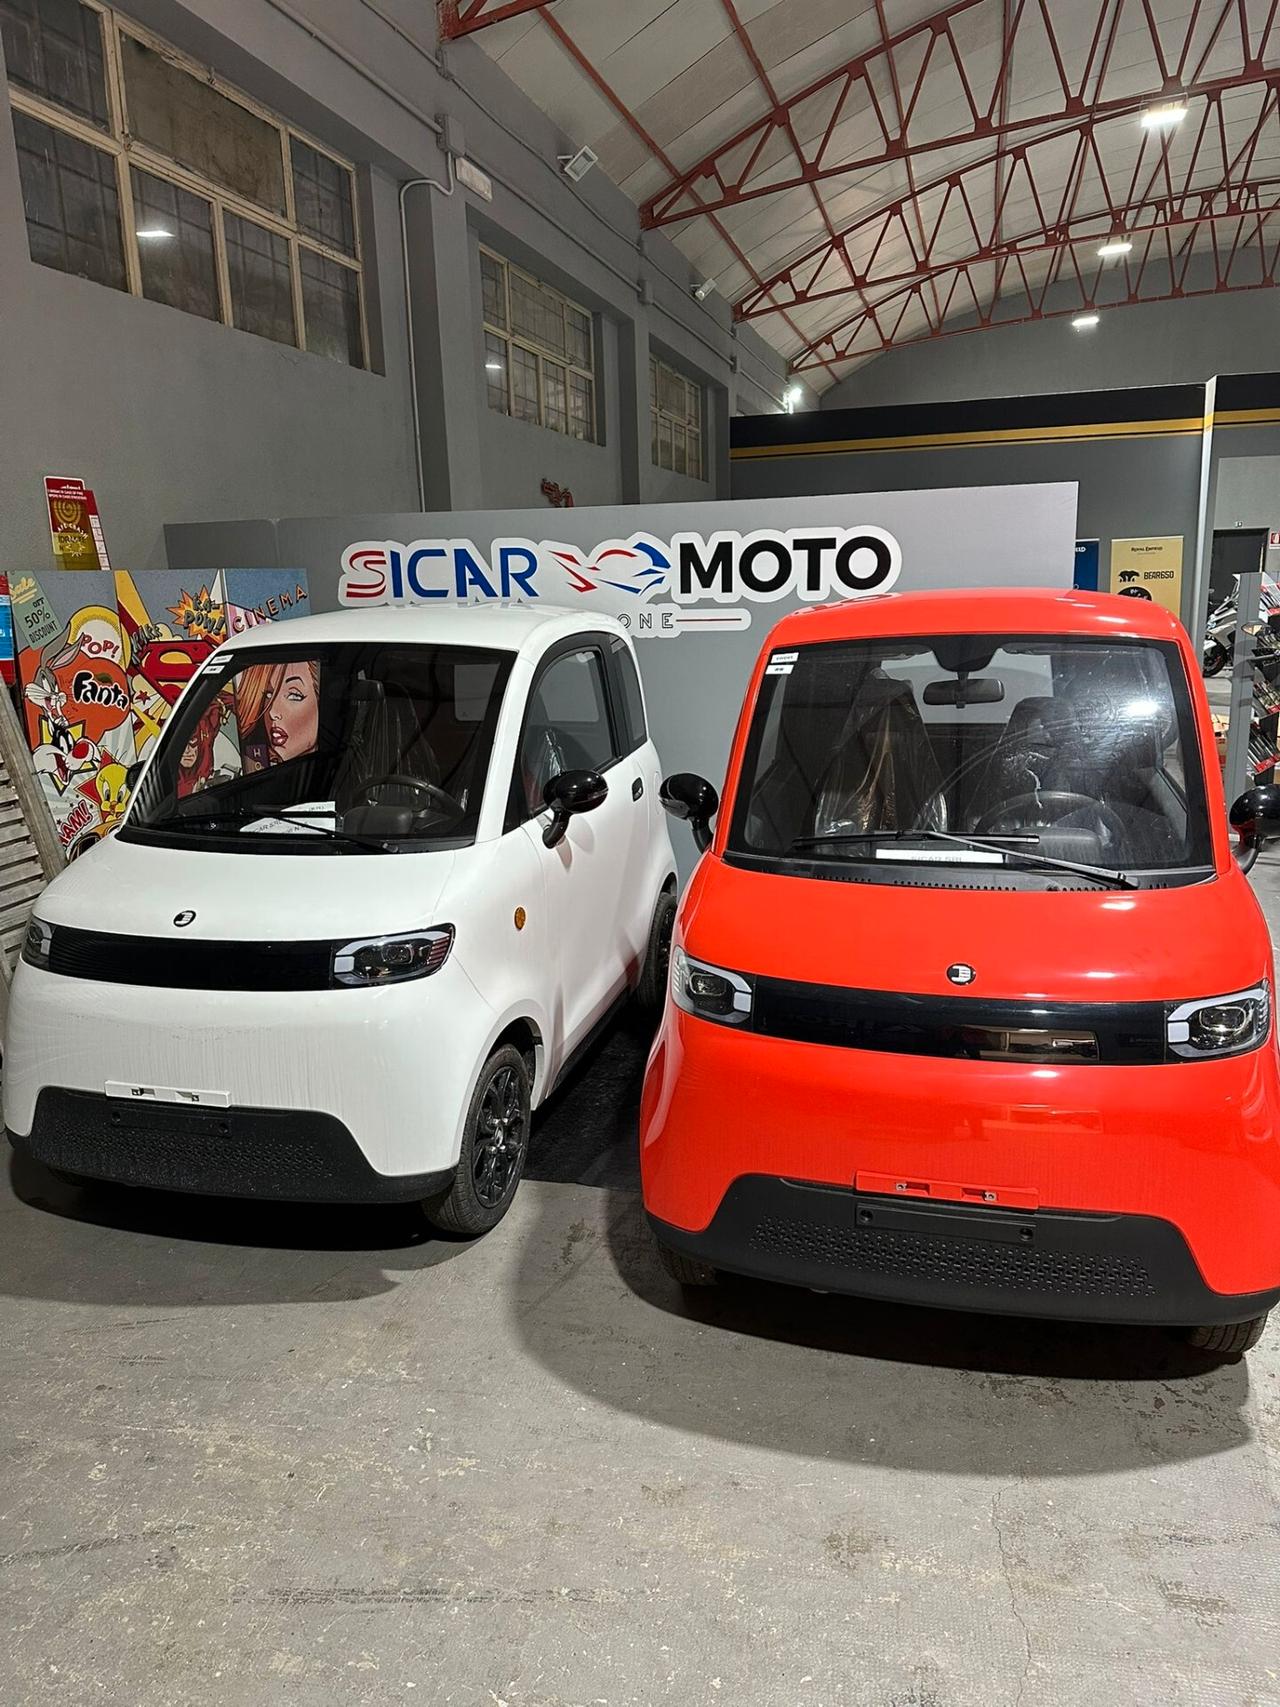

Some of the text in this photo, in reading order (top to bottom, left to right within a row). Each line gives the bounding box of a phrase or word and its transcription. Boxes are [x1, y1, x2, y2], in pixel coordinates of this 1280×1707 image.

[345, 535, 891, 598] SICAR MOTO
[33, 597, 45, 608] OFF
[232, 584, 308, 633] CINEMA
[24, 606, 51, 629] 50%
[184, 609, 226, 635] POW!
[617, 613, 673, 629] ONE
[28, 620, 58, 644] DISCOUNT
[82, 633, 119, 658] POP!
[73, 671, 129, 711] Fanta
